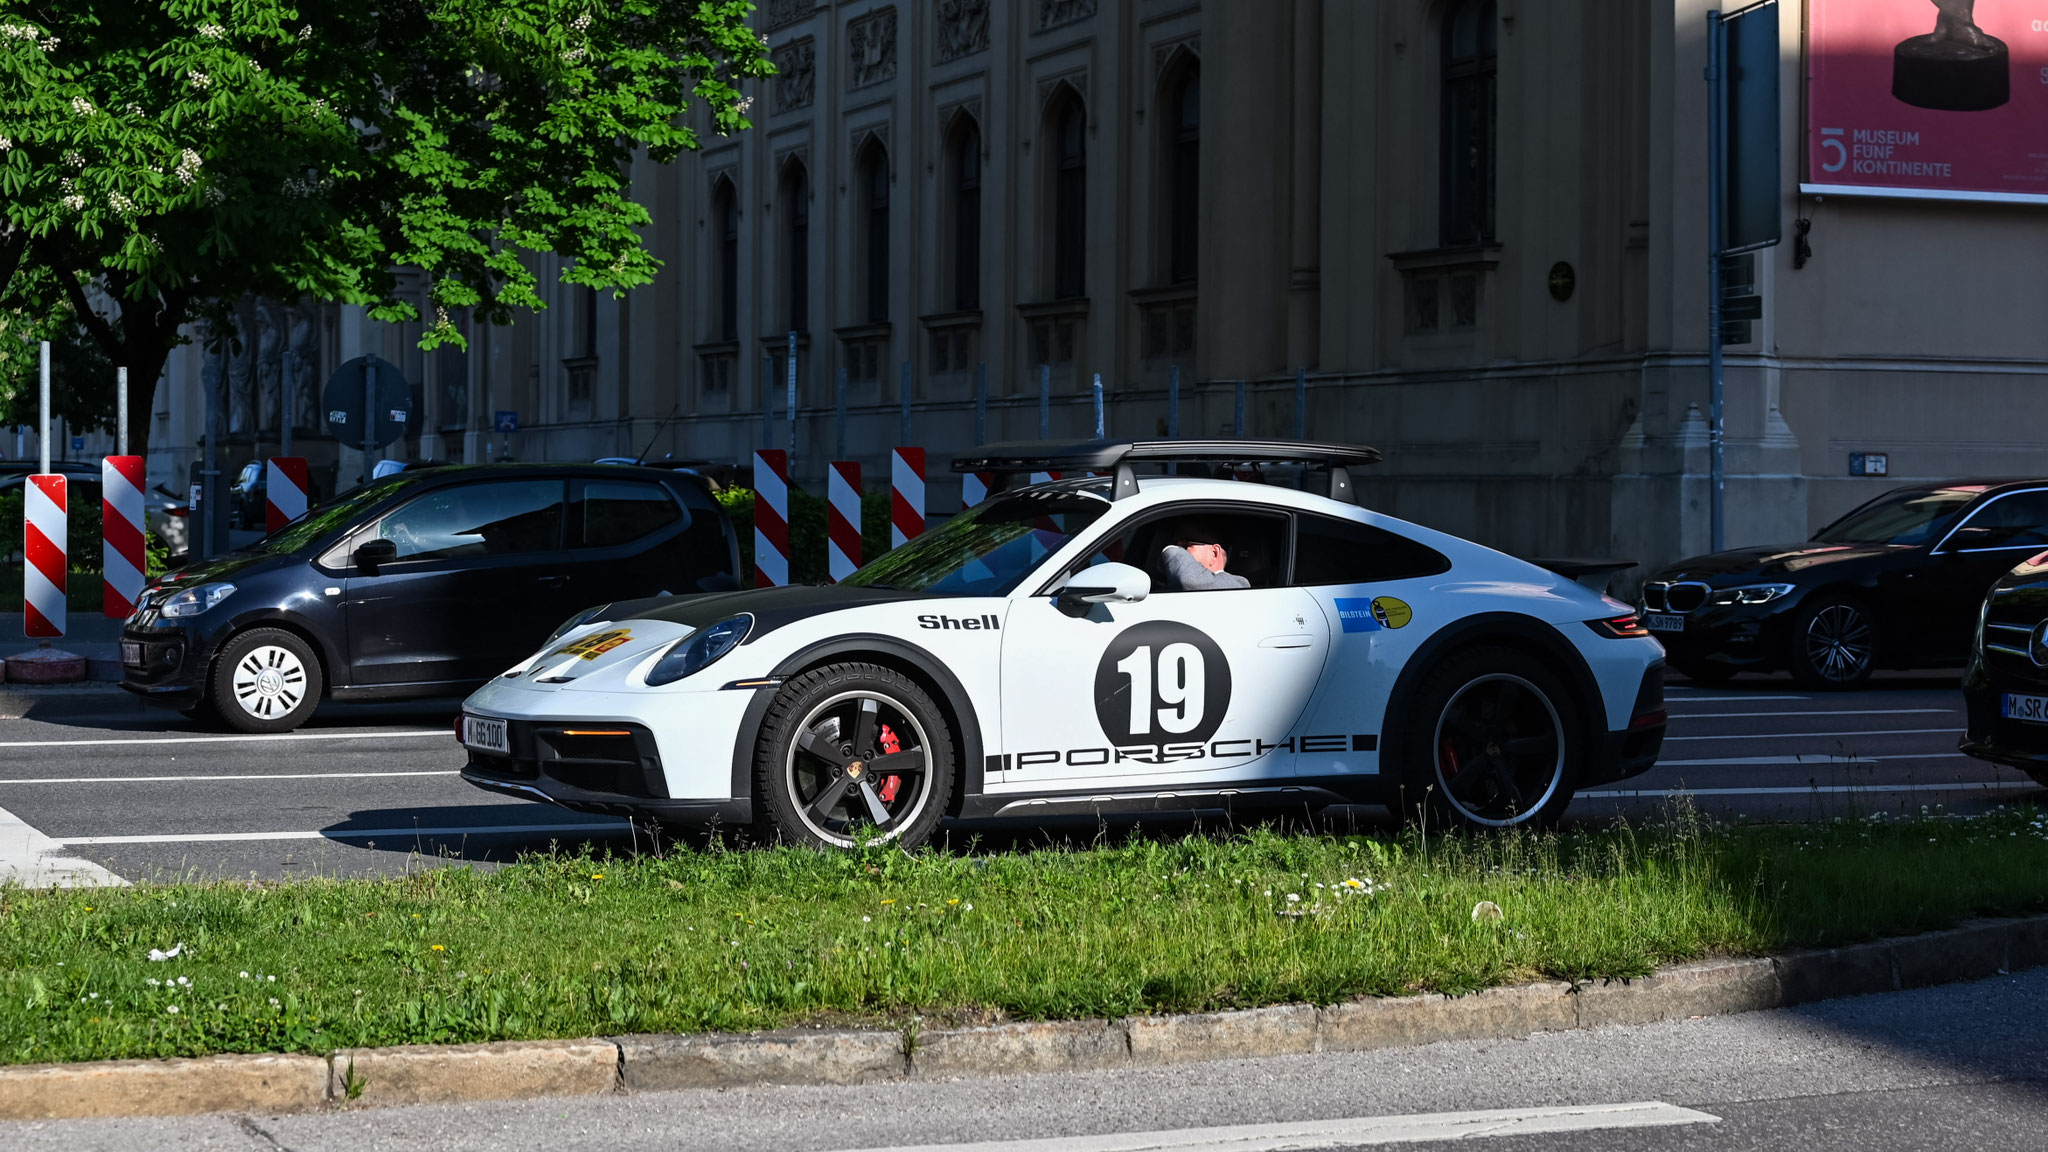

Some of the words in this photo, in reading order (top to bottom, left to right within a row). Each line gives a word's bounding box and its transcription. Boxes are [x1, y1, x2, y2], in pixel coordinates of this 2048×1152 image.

[1853, 129, 1919, 146] MUSEUM
[1853, 144, 1895, 159] FÜNF
[1853, 160, 1952, 178] KONTINENTE
[917, 614, 1000, 630] Shell
[1340, 610, 1371, 619] BILSTEIN
[1117, 642, 1205, 735] 19
[2008, 696, 2017, 715] M
[1017, 735, 1347, 770] PORSCHE
